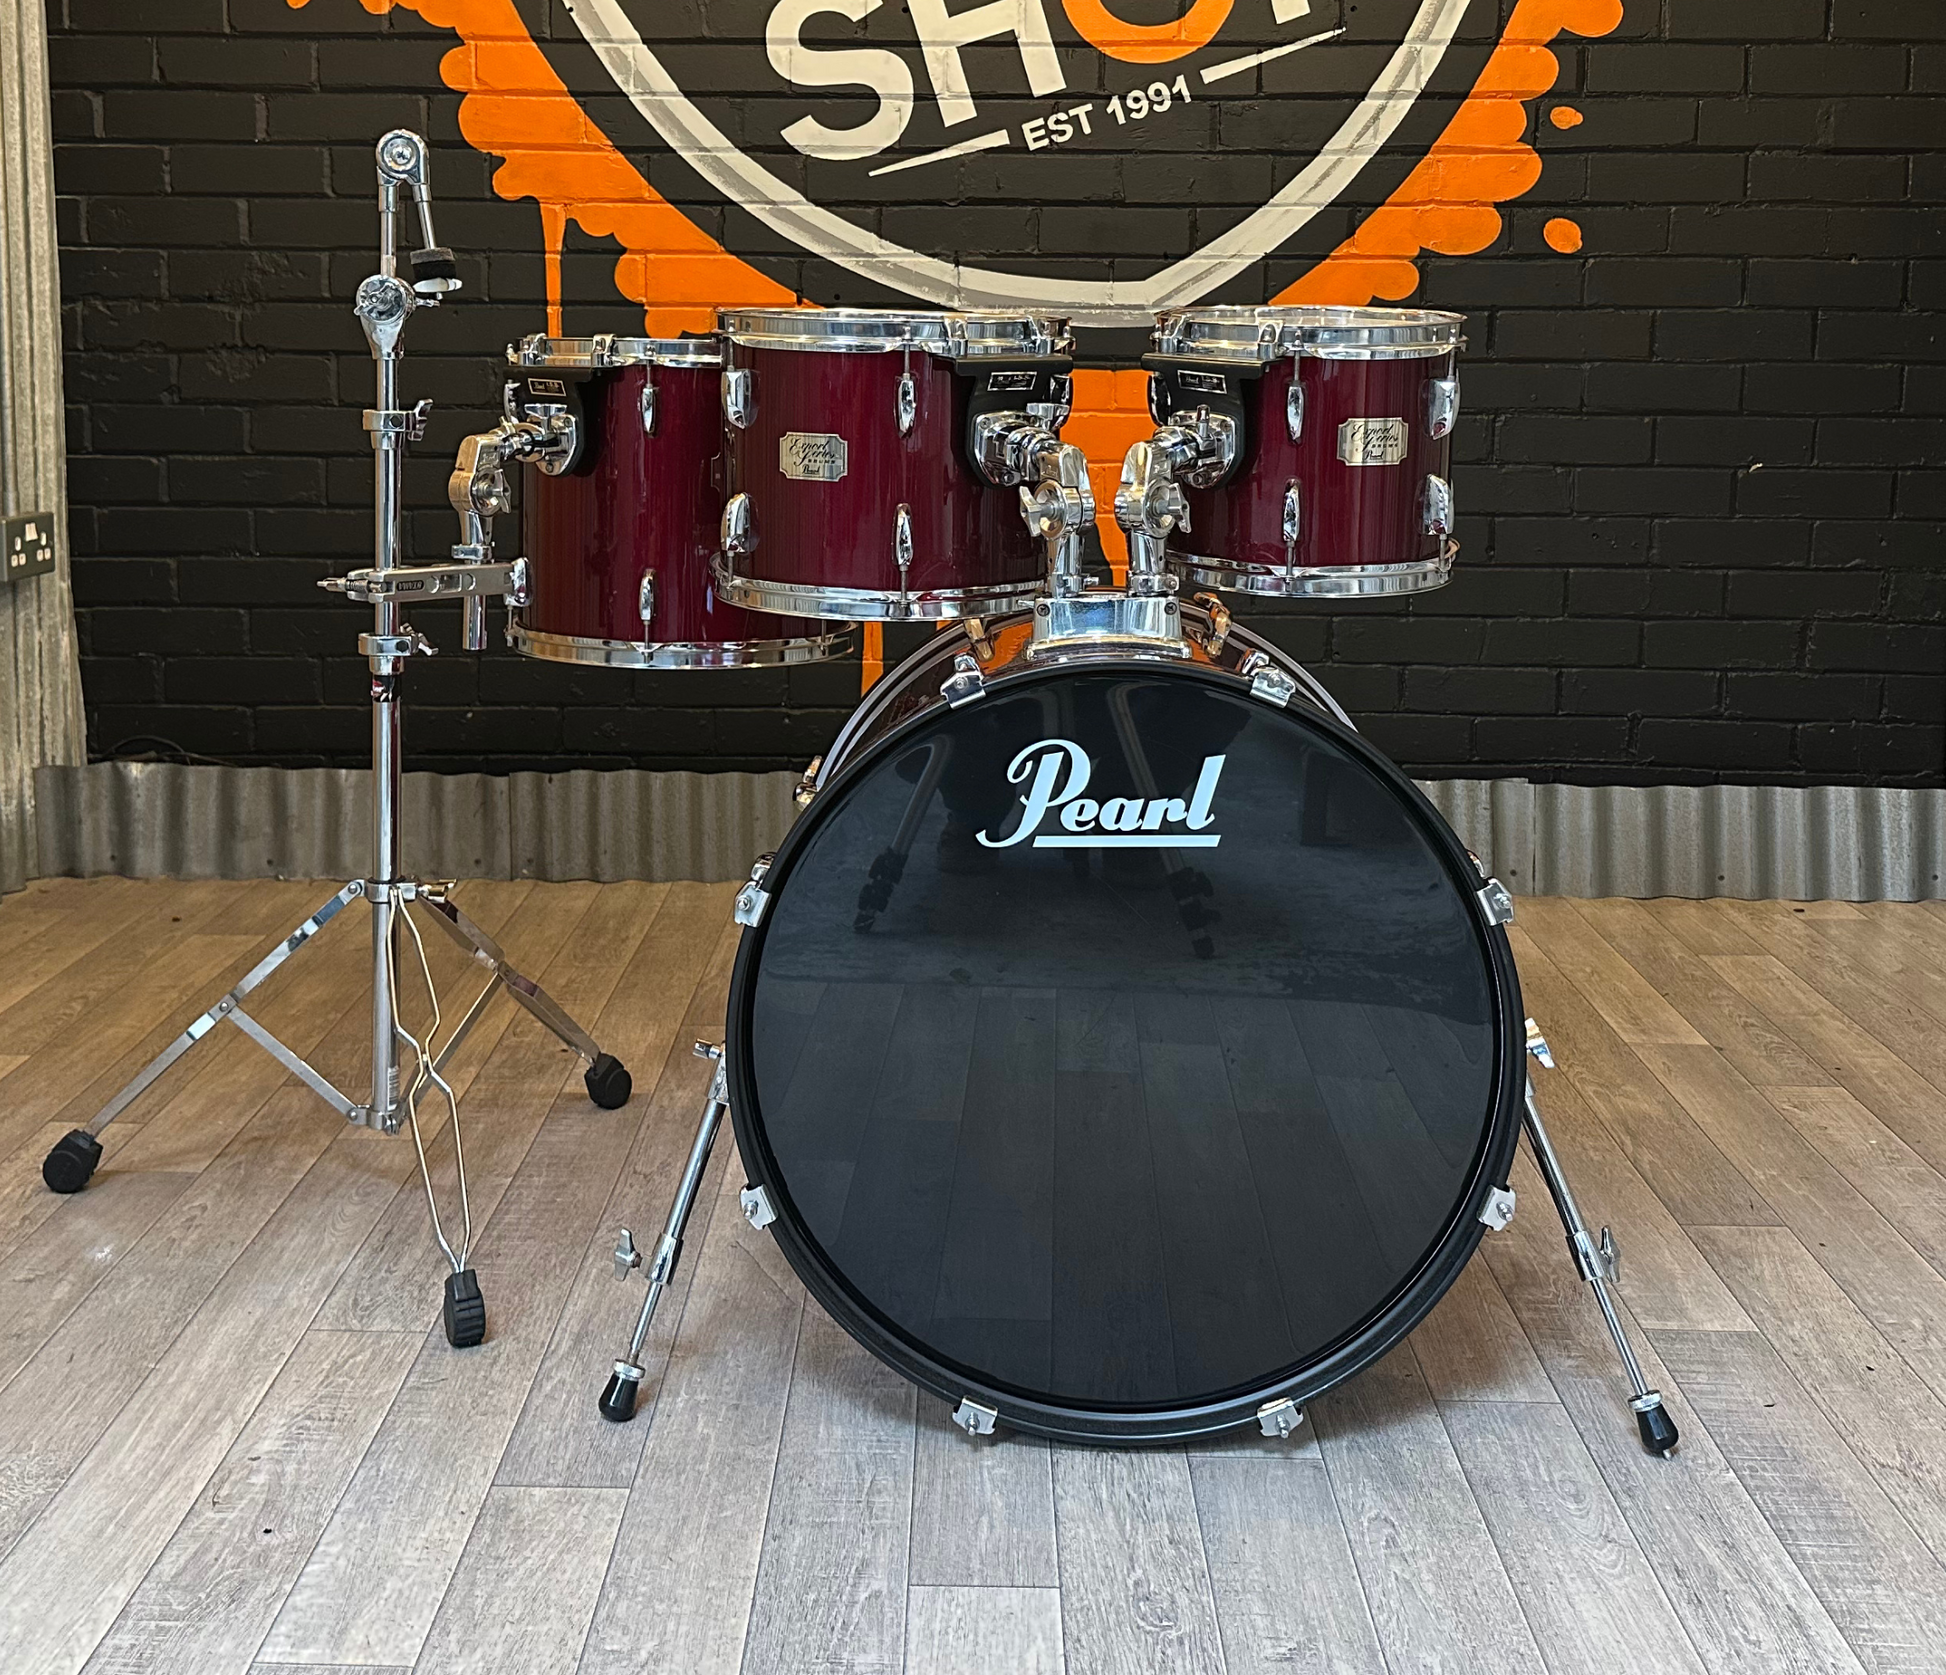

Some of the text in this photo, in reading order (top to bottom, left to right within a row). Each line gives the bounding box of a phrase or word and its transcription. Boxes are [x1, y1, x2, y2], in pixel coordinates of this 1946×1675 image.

[1021, 74, 1192, 151] EST 1991
[789, 438, 830, 455] Export
[975, 738, 1227, 848] Pearl
